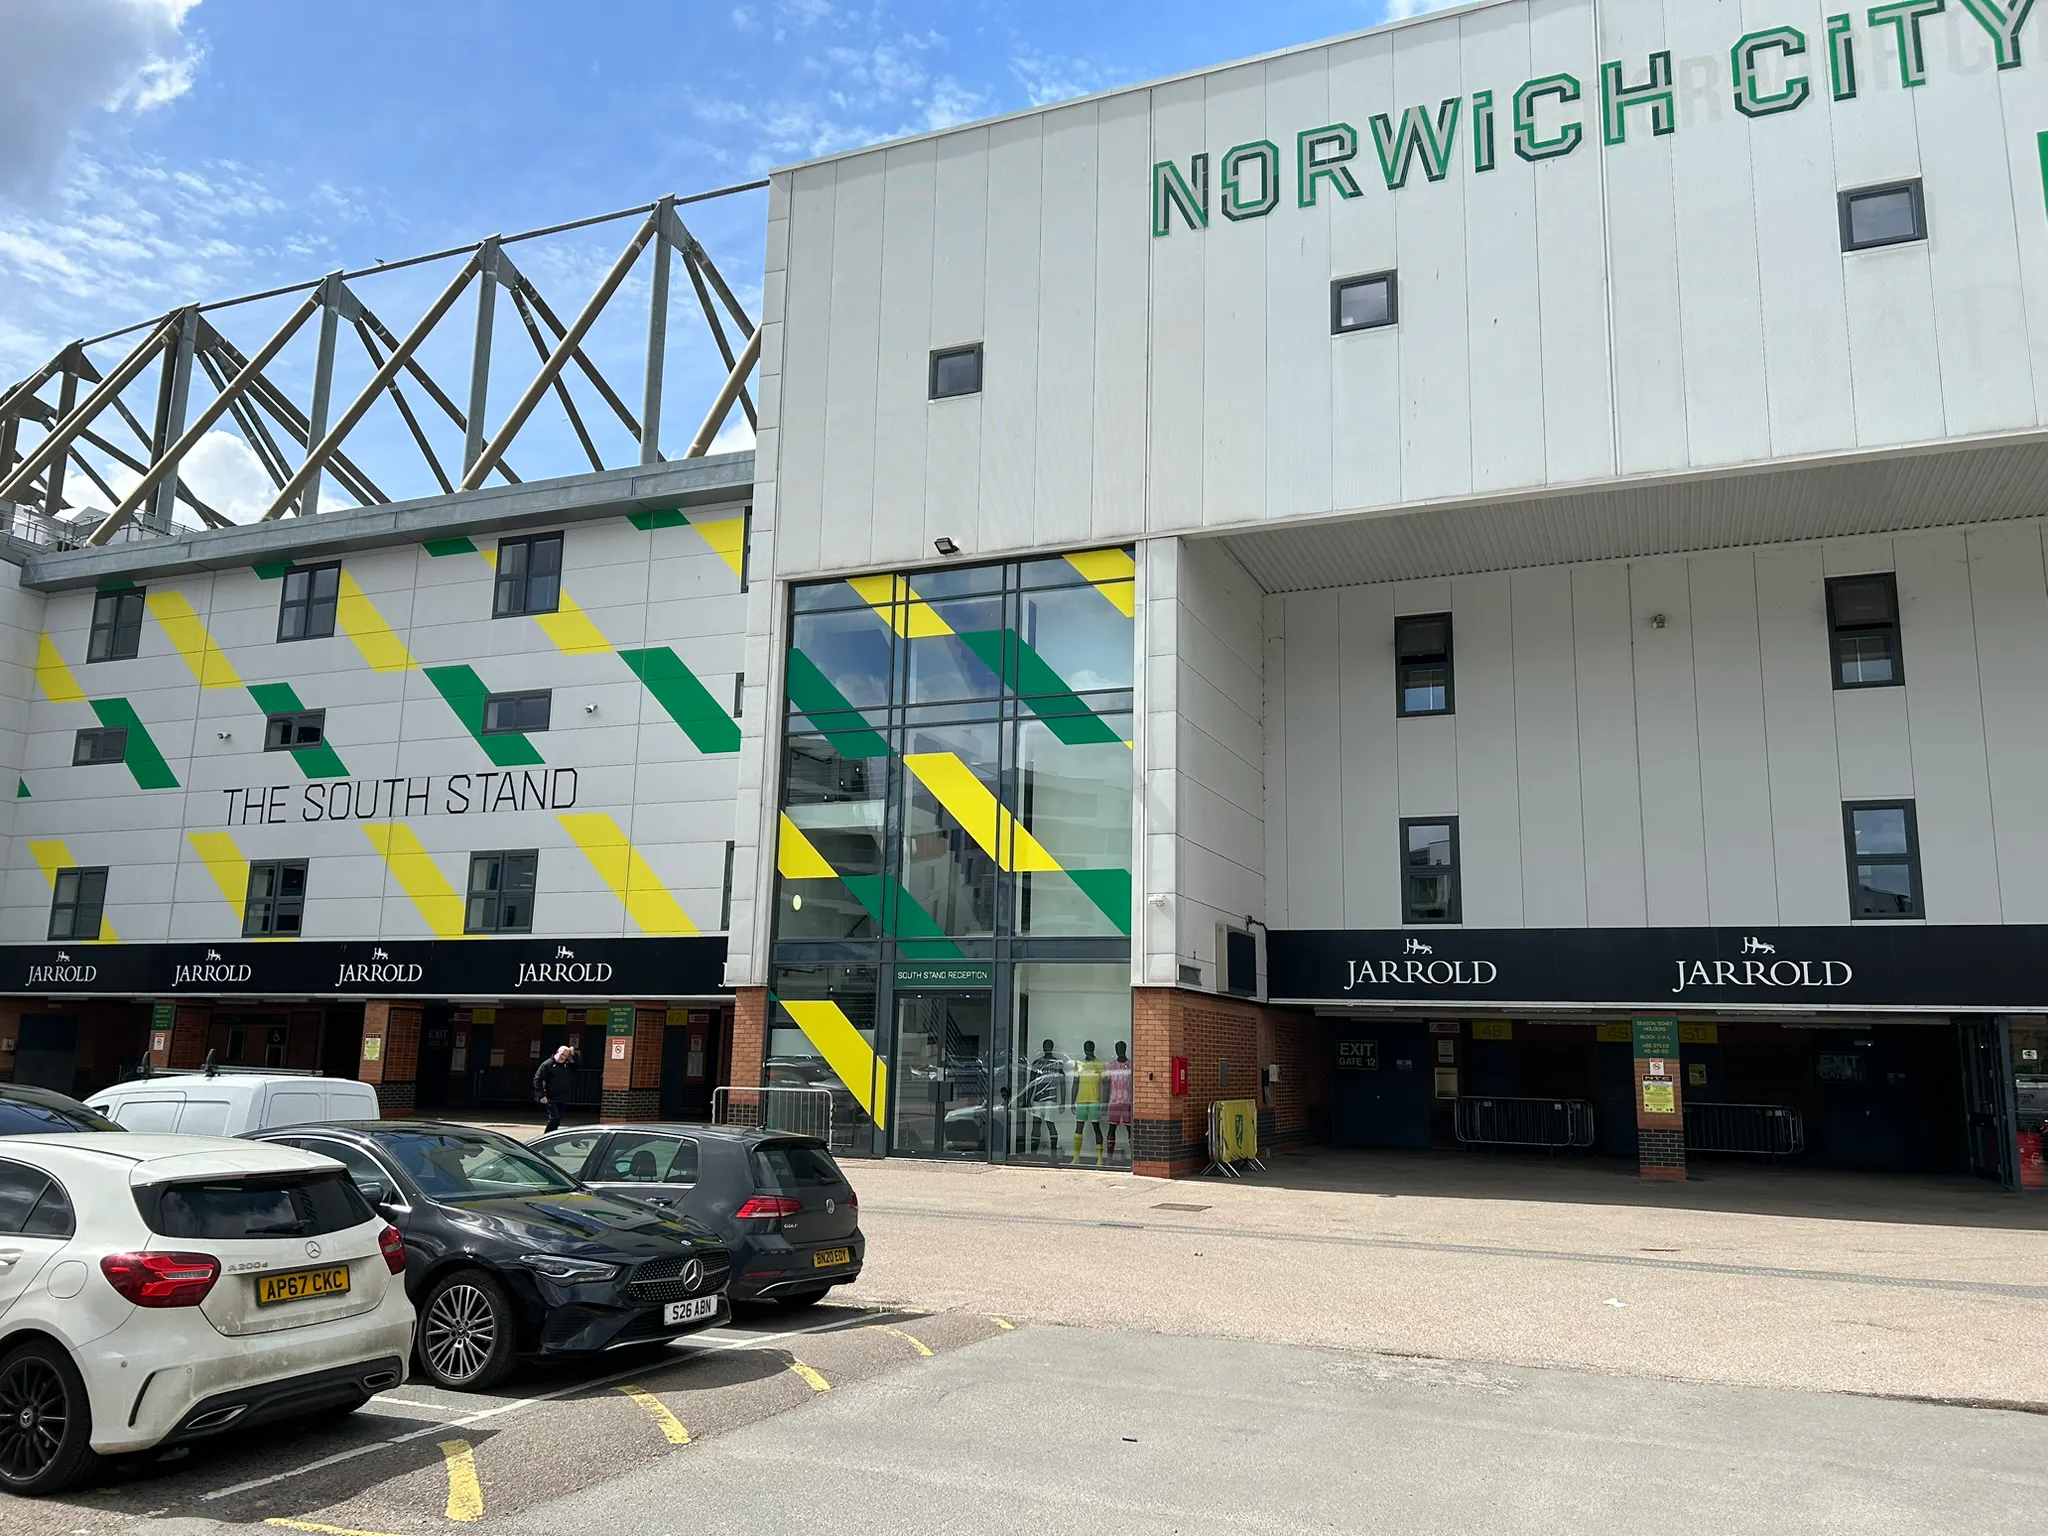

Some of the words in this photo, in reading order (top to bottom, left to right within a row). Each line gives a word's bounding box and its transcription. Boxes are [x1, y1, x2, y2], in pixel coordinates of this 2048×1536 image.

[1152, 50, 1673, 238] NORWICH
[1731, 0, 2035, 118] CITY
[223, 785, 290, 826] THE
[302, 776, 430, 822] SOUTH
[446, 767, 578, 814] STAND
[26, 965, 97, 987] JARROLD
[172, 965, 252, 987] JARROLD
[335, 965, 423, 987] JARROLD
[514, 963, 612, 987] JARROLD
[897, 971, 922, 980] SOUTH
[923, 971, 947, 980] STAND
[948, 971, 988, 980] RECEPTION
[1344, 960, 1497, 990] JARROLD
[1672, 960, 1853, 993] JARROLD
[1481, 1025, 1503, 1038] 48
[1607, 1026, 1629, 1039] 49
[1339, 1042, 1374, 1057] EXIT
[1338, 1056, 1363, 1067] GATE
[1365, 1057, 1377, 1067] 12
[1818, 1054, 1861, 1069] EXIT
[816, 1251, 834, 1265] BN20
[266, 1275, 308, 1300] AP67
[313, 1270, 343, 1292] CKC
[672, 1302, 692, 1320] S26
[694, 1298, 712, 1317] ABN
